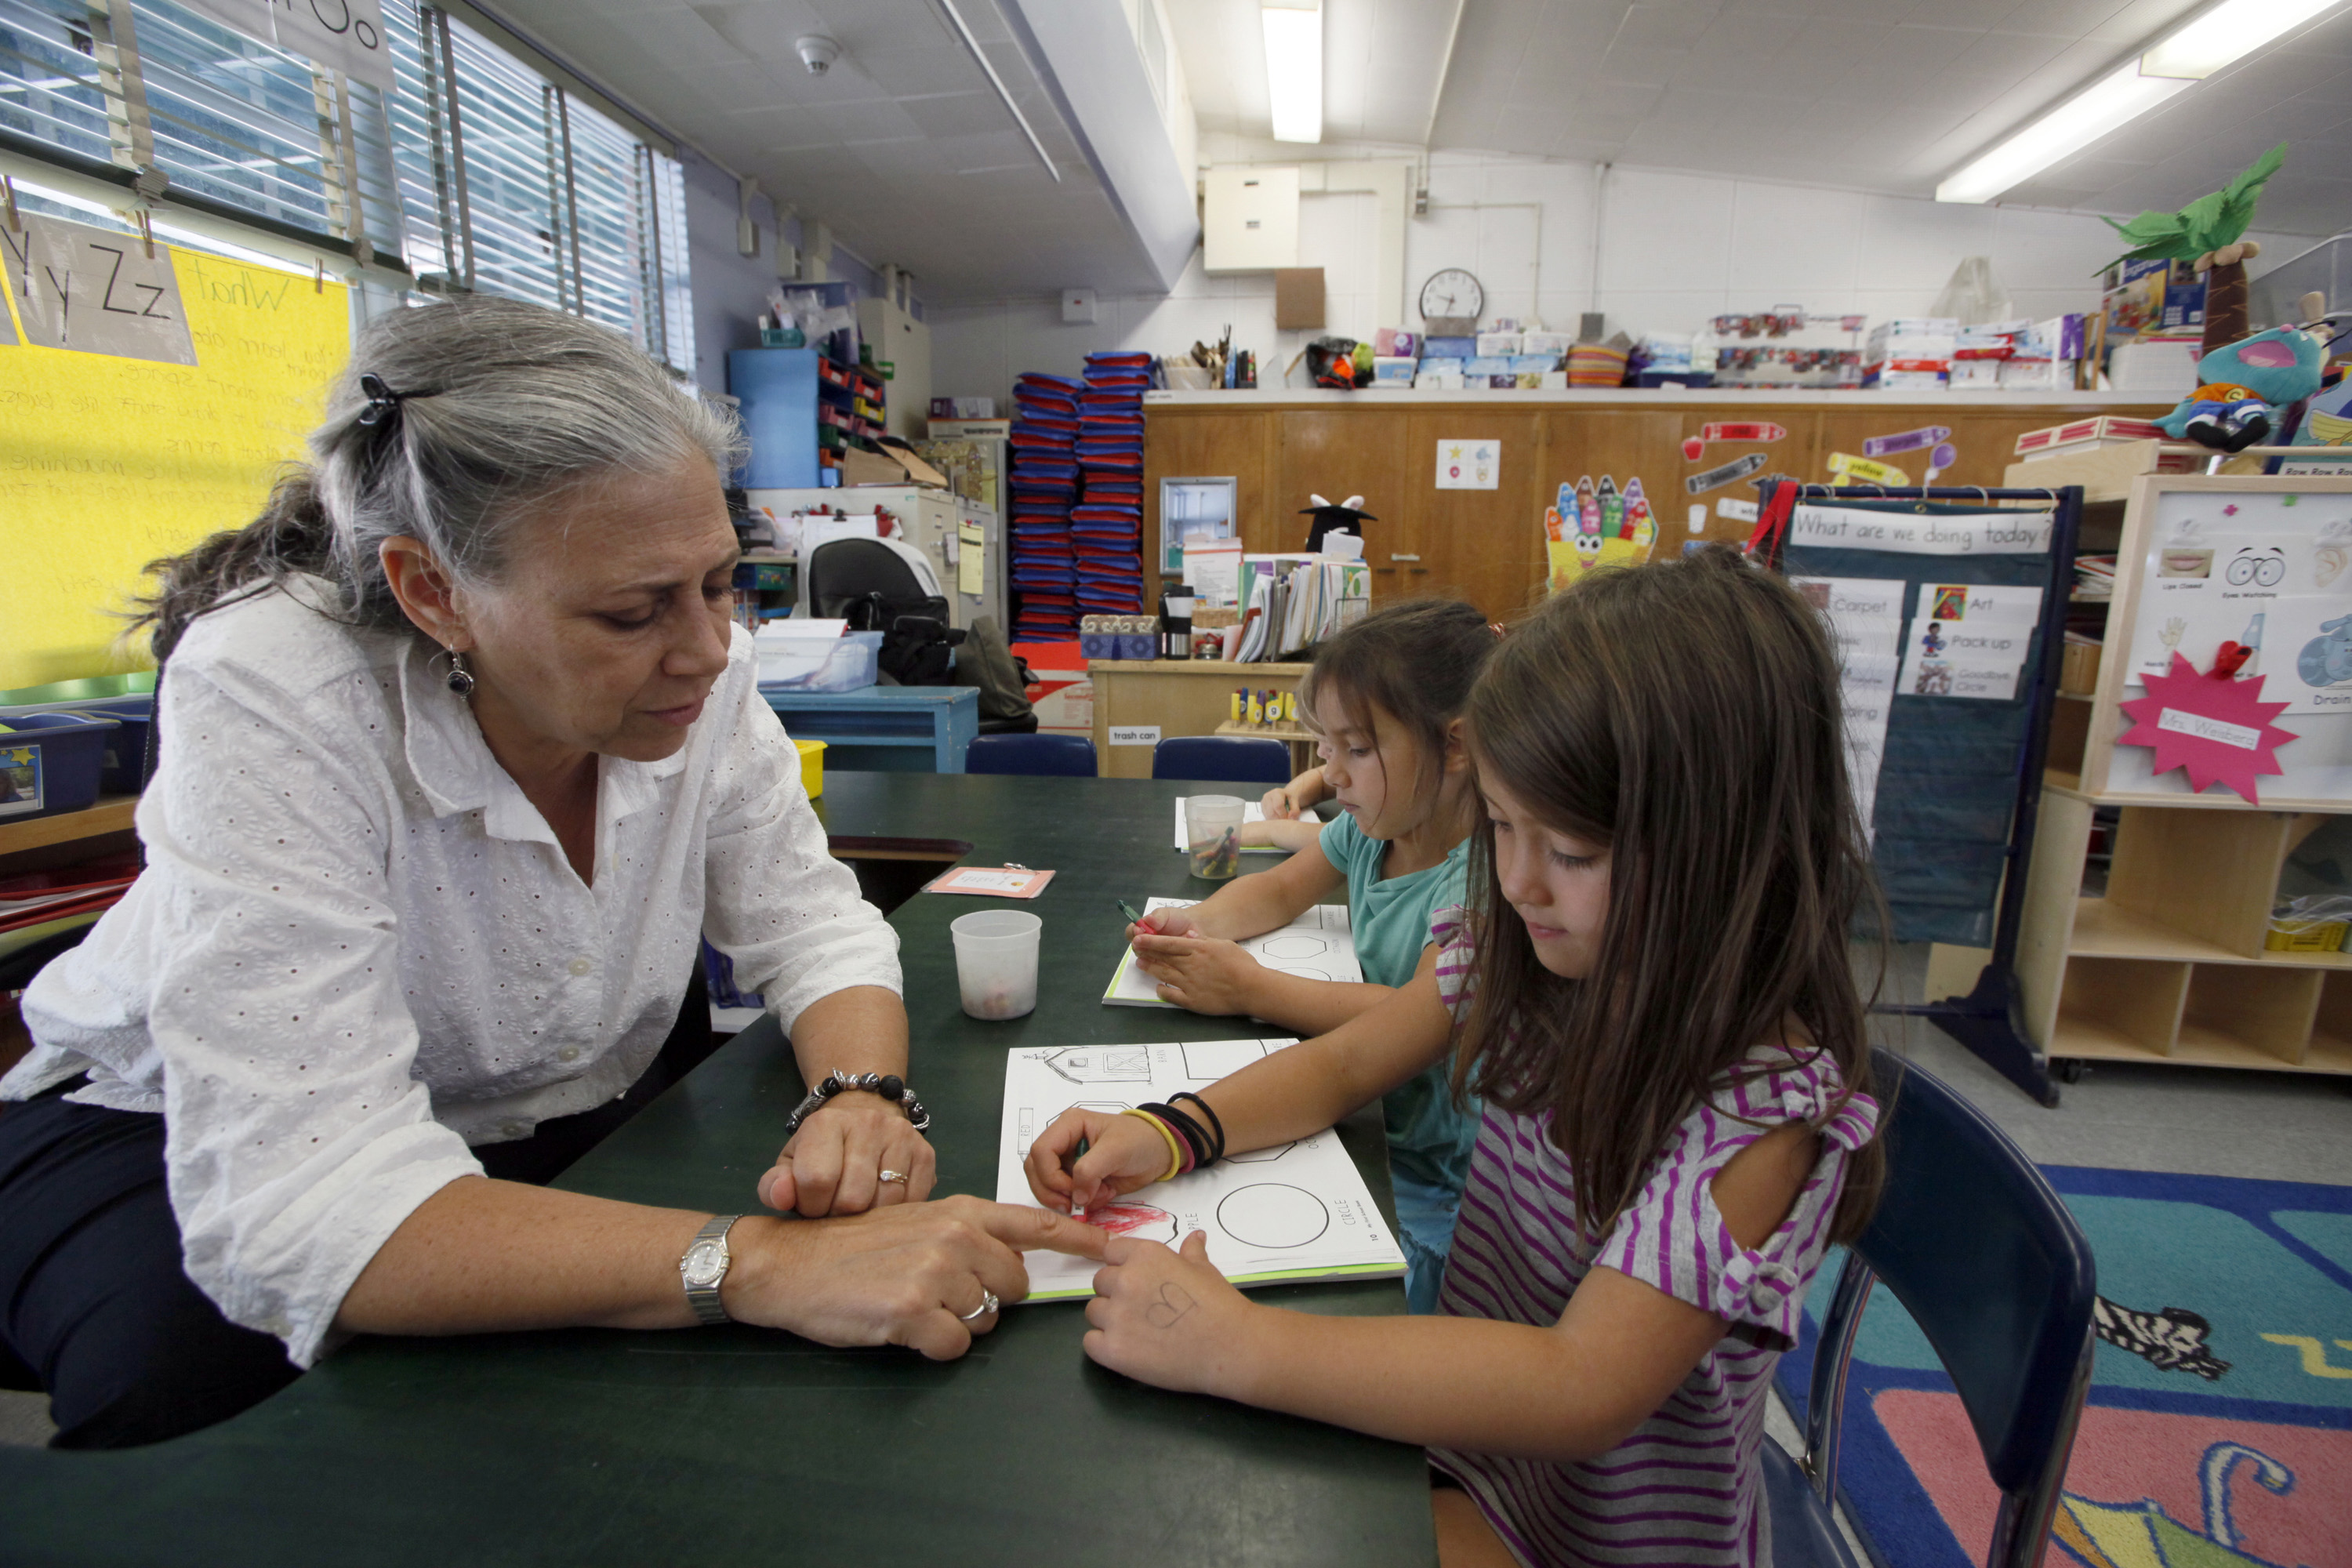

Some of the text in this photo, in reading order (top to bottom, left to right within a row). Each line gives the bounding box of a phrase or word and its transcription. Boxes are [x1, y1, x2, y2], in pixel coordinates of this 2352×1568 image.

[0, 224, 172, 343] Yy Zz
[1795, 512, 1850, 536] What
[1856, 524, 1884, 539] are
[1893, 527, 1915, 541] we
[1922, 523, 1973, 550] doing
[1834, 598, 1888, 614] Carpet
[1969, 598, 1993, 610] Art
[1951, 635, 2012, 651] Pack up
[1020, 1124, 1031, 1137] RED
[1334, 1199, 1356, 1225] CIRCLE
[1185, 1212, 1200, 1230] PPLE
